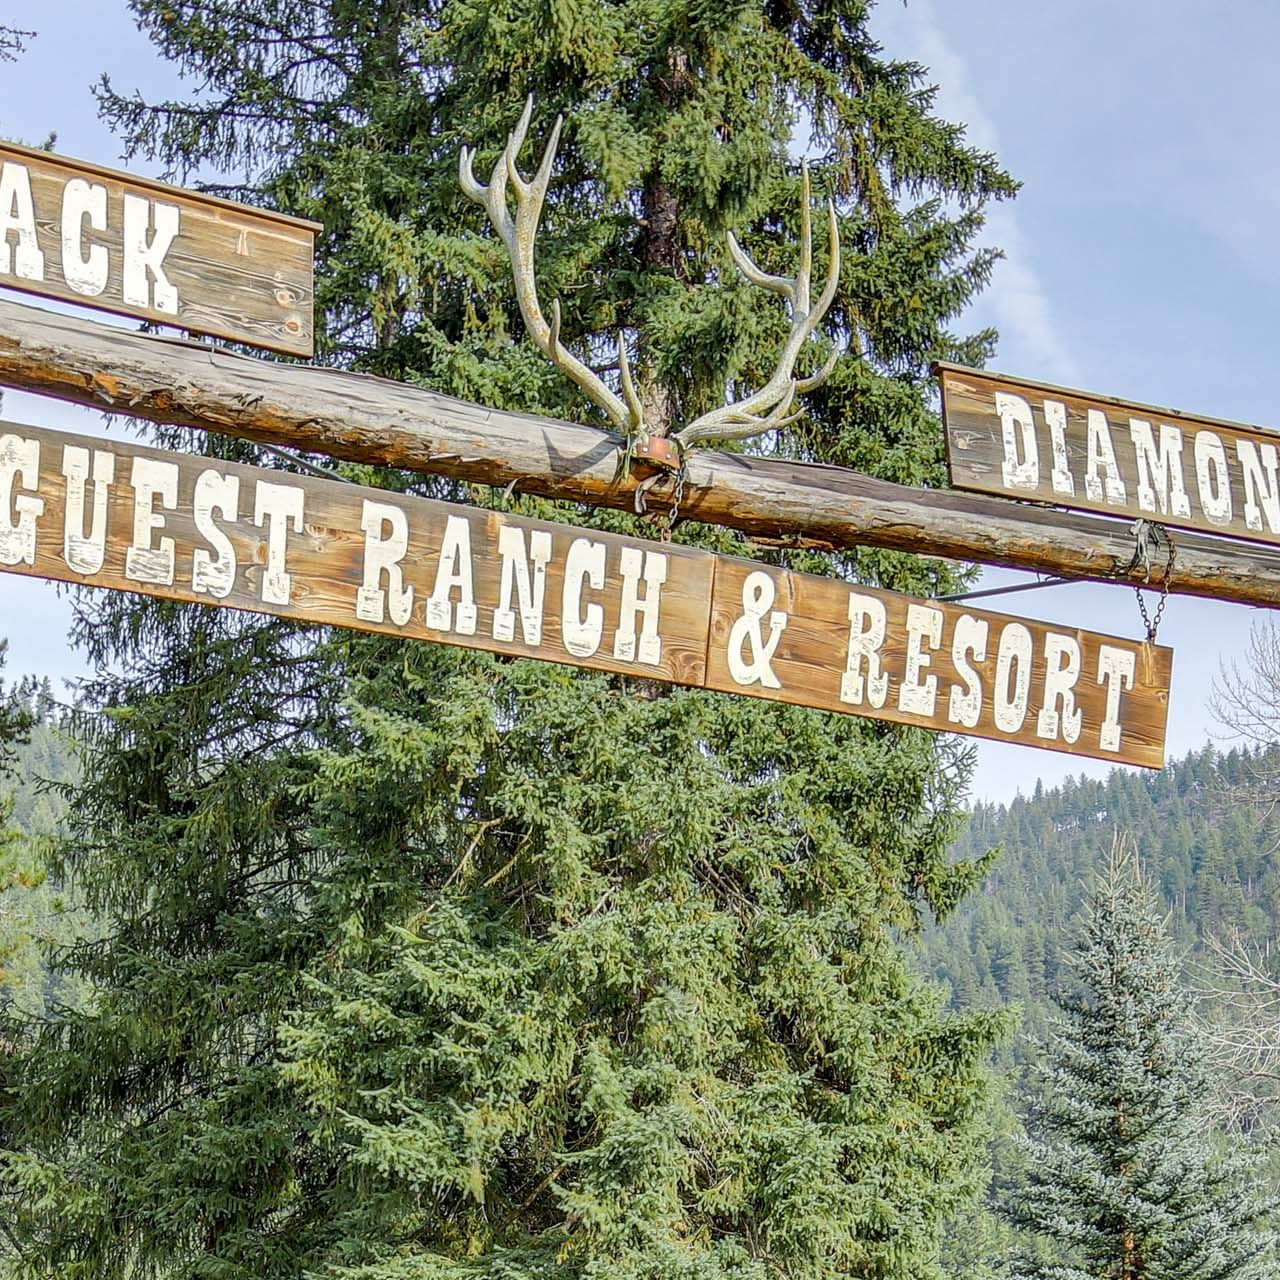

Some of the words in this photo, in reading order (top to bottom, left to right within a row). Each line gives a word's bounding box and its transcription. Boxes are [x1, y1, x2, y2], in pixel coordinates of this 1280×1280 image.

[356, 498, 669, 667] RANCH
[726, 570, 789, 691] &
[839, 592, 1136, 753] RESORT
